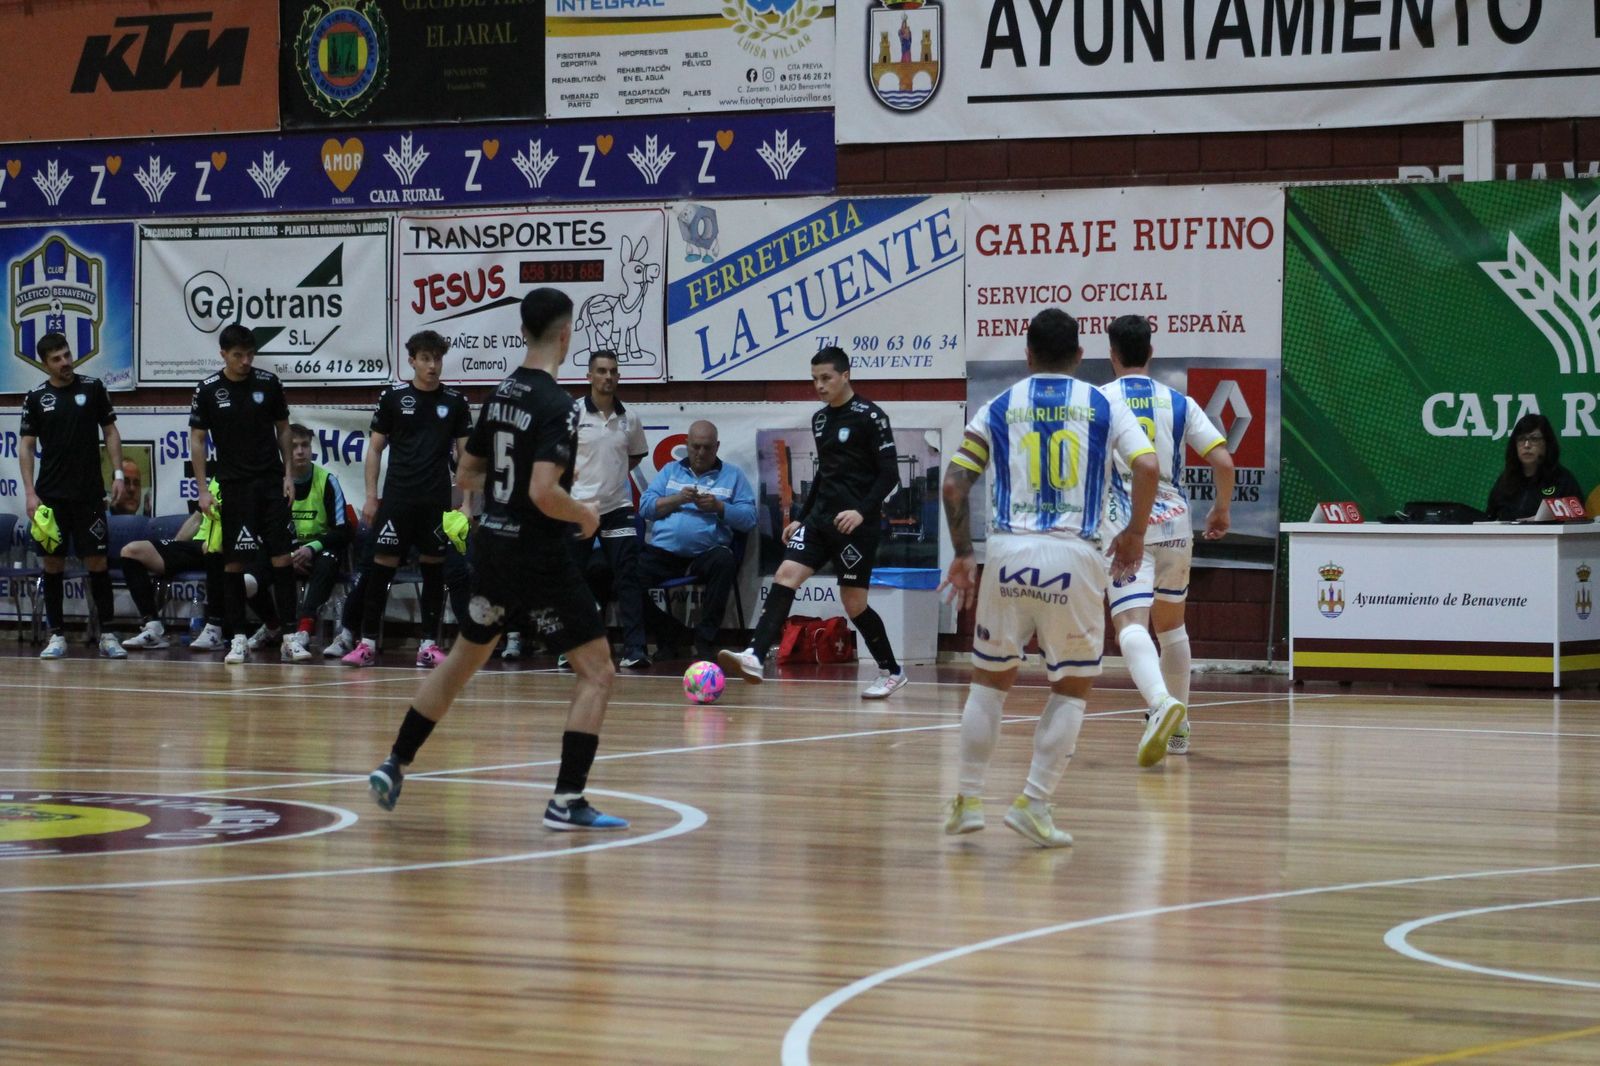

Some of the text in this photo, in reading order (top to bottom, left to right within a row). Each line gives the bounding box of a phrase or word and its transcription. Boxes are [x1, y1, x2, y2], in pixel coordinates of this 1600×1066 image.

[426, 22, 518, 48] EL JARAL
[70, 12, 250, 93] KTM
[618, 48, 669, 58] HIPOPRESIVOS
[737, 33, 812, 59] LUISA VILLAR
[556, 51, 601, 60] FISIOTERAPIA
[682, 59, 712, 67] PÉLVICO
[685, 51, 708, 59] SUELO
[617, 64, 671, 74] REHABILITACIÓN
[802, 63, 823, 71] PREVIA
[551, 74, 606, 84] REHABILITACIÓN
[803, 73, 812, 81] 46
[813, 73, 823, 81] 26
[824, 72, 832, 80] 21
[618, 87, 670, 97] READAPTACIÓN
[683, 89, 712, 97] PILATES
[779, 84, 796, 92] BAJO
[560, 93, 600, 101] EMBARAZO
[568, 101, 591, 109] PARTO
[625, 97, 663, 105] DEPORTIVA
[324, 153, 362, 172] AMOR
[578, 145, 596, 188] Z
[697, 140, 716, 184] Z
[464, 150, 482, 192] Z
[90, 166, 107, 206] Z
[195, 161, 212, 202] Z
[369, 187, 444, 204] CAJA RURAL
[198, 227, 240, 238] MOVIMIENTO
[250, 225, 278, 236] TIERRAS
[409, 220, 607, 249] TRANSPORTES
[975, 216, 1275, 258] GARAJE RUFINO
[685, 202, 864, 310] FERRETERIA
[47, 265, 65, 275] CLUB
[521, 265, 544, 281] 658
[552, 263, 574, 280] 913
[53, 287, 97, 305] BENAVENTE
[411, 265, 506, 315] JESUS
[695, 207, 959, 374] LA FUENTE
[977, 282, 1168, 306] SERVICIO OFICIAL
[191, 286, 344, 325] Gejotrans
[1168, 311, 1246, 333] ESPAÑA
[288, 329, 315, 346] S.L.
[484, 335, 498, 349] DE
[853, 335, 879, 351] 980
[886, 335, 904, 350] 63
[913, 335, 931, 350] 06
[939, 334, 958, 350] 34
[294, 360, 321, 374] 666
[326, 360, 353, 373] 416
[358, 359, 384, 373] 289
[462, 357, 507, 373] (Zamora)
[849, 355, 934, 369] ENAVENTE
[1421, 392, 1541, 441] CAJA
[493, 430, 516, 505] 5
[1020, 428, 1080, 492] 10
[377, 537, 399, 546] ACTIO
[999, 565, 1071, 590] KIA
[1000, 586, 1069, 605] BUSANAUTO
[1353, 591, 1528, 608] Ayuntamiento de Benavente
